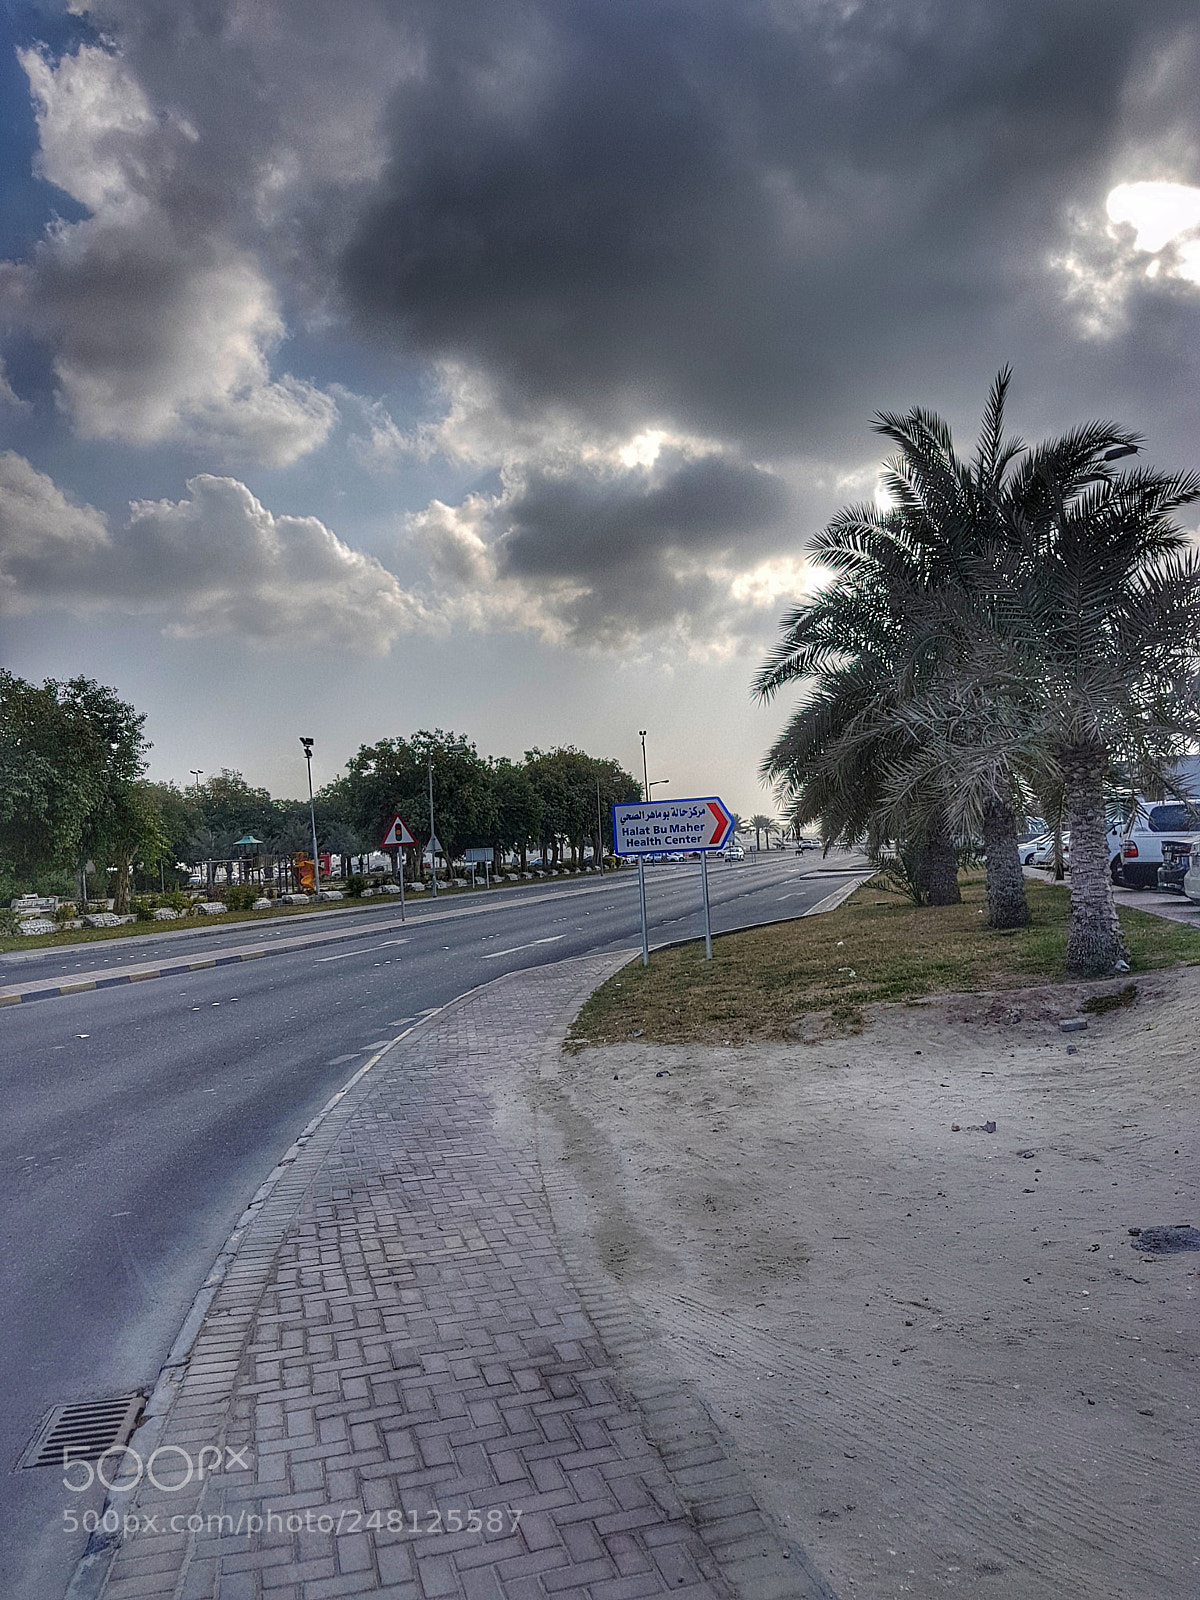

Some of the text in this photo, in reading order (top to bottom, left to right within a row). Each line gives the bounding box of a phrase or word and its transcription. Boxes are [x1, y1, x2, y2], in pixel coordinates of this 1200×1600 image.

[620, 806, 705, 825] مركز حالة بو ماهر الصحي
[622, 823, 705, 836] Halat Bu Maher
[626, 835, 702, 847] Health Center
